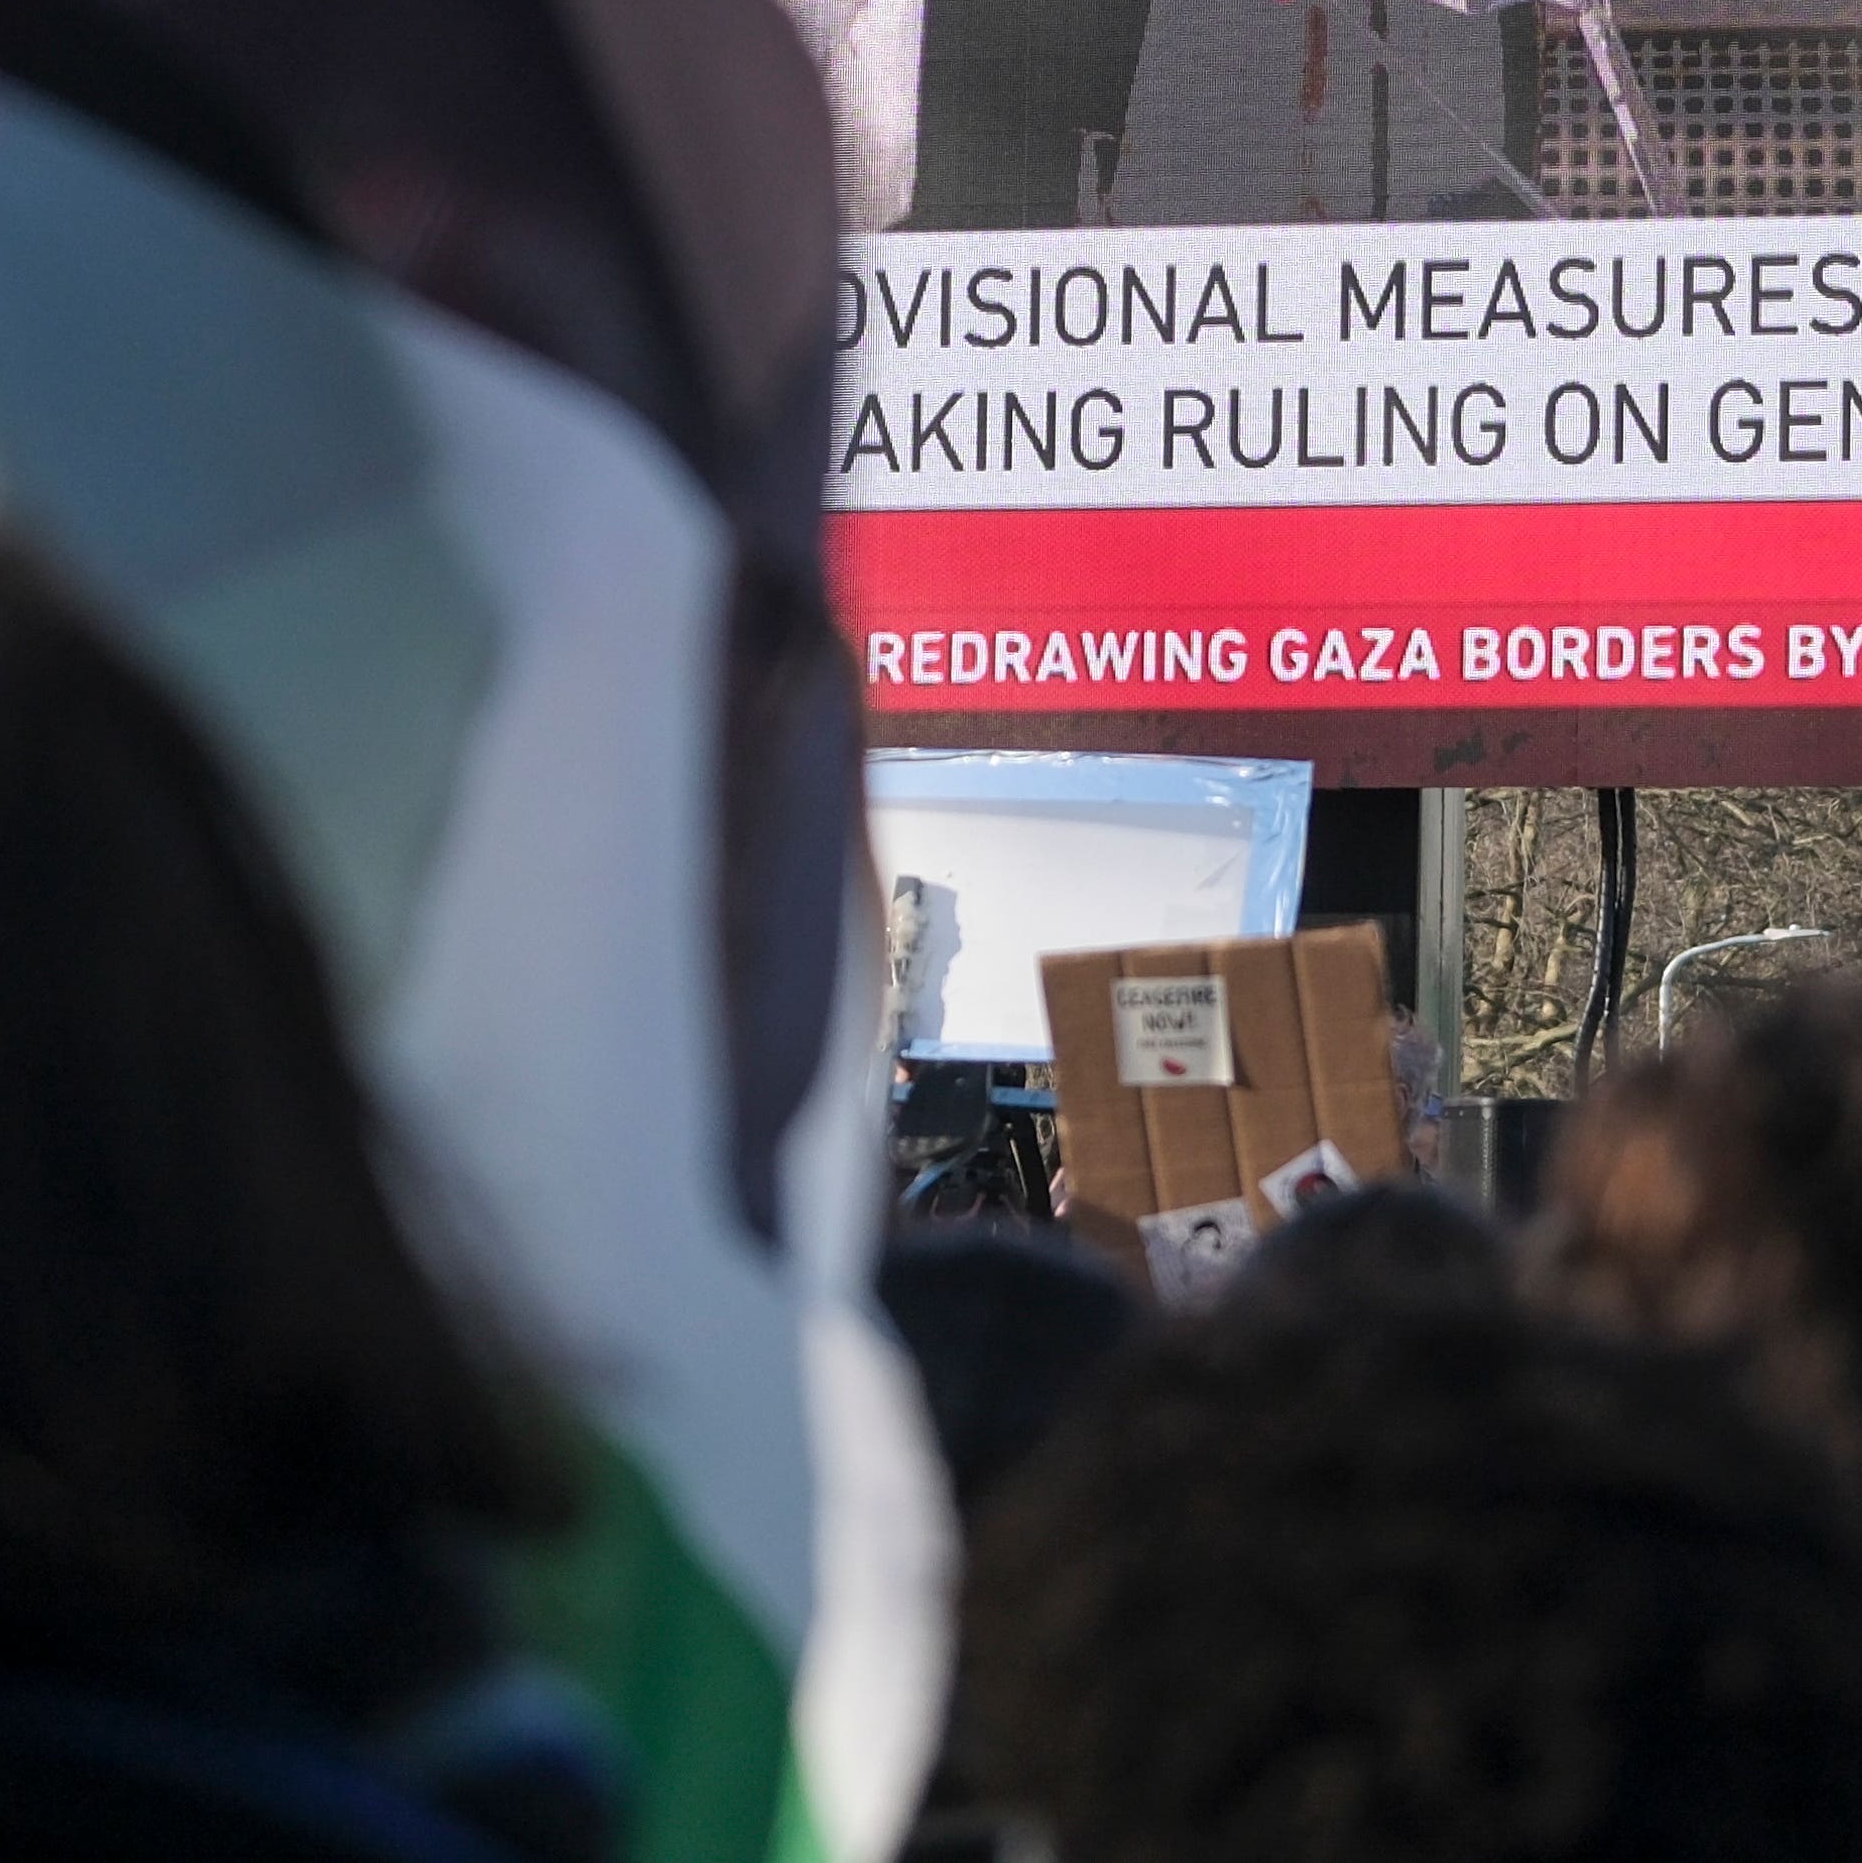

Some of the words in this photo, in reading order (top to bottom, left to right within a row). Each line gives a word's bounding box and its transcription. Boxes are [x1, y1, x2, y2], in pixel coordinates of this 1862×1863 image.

[1339, 251, 1862, 341] MEASURES
[840, 389, 1124, 473] AKING
[1162, 382, 1506, 469] RULING
[1543, 379, 1669, 465] ON
[870, 629, 1248, 685] REDRAWING
[1270, 626, 1440, 682] GAZA
[1462, 624, 1765, 681] BORDERS
